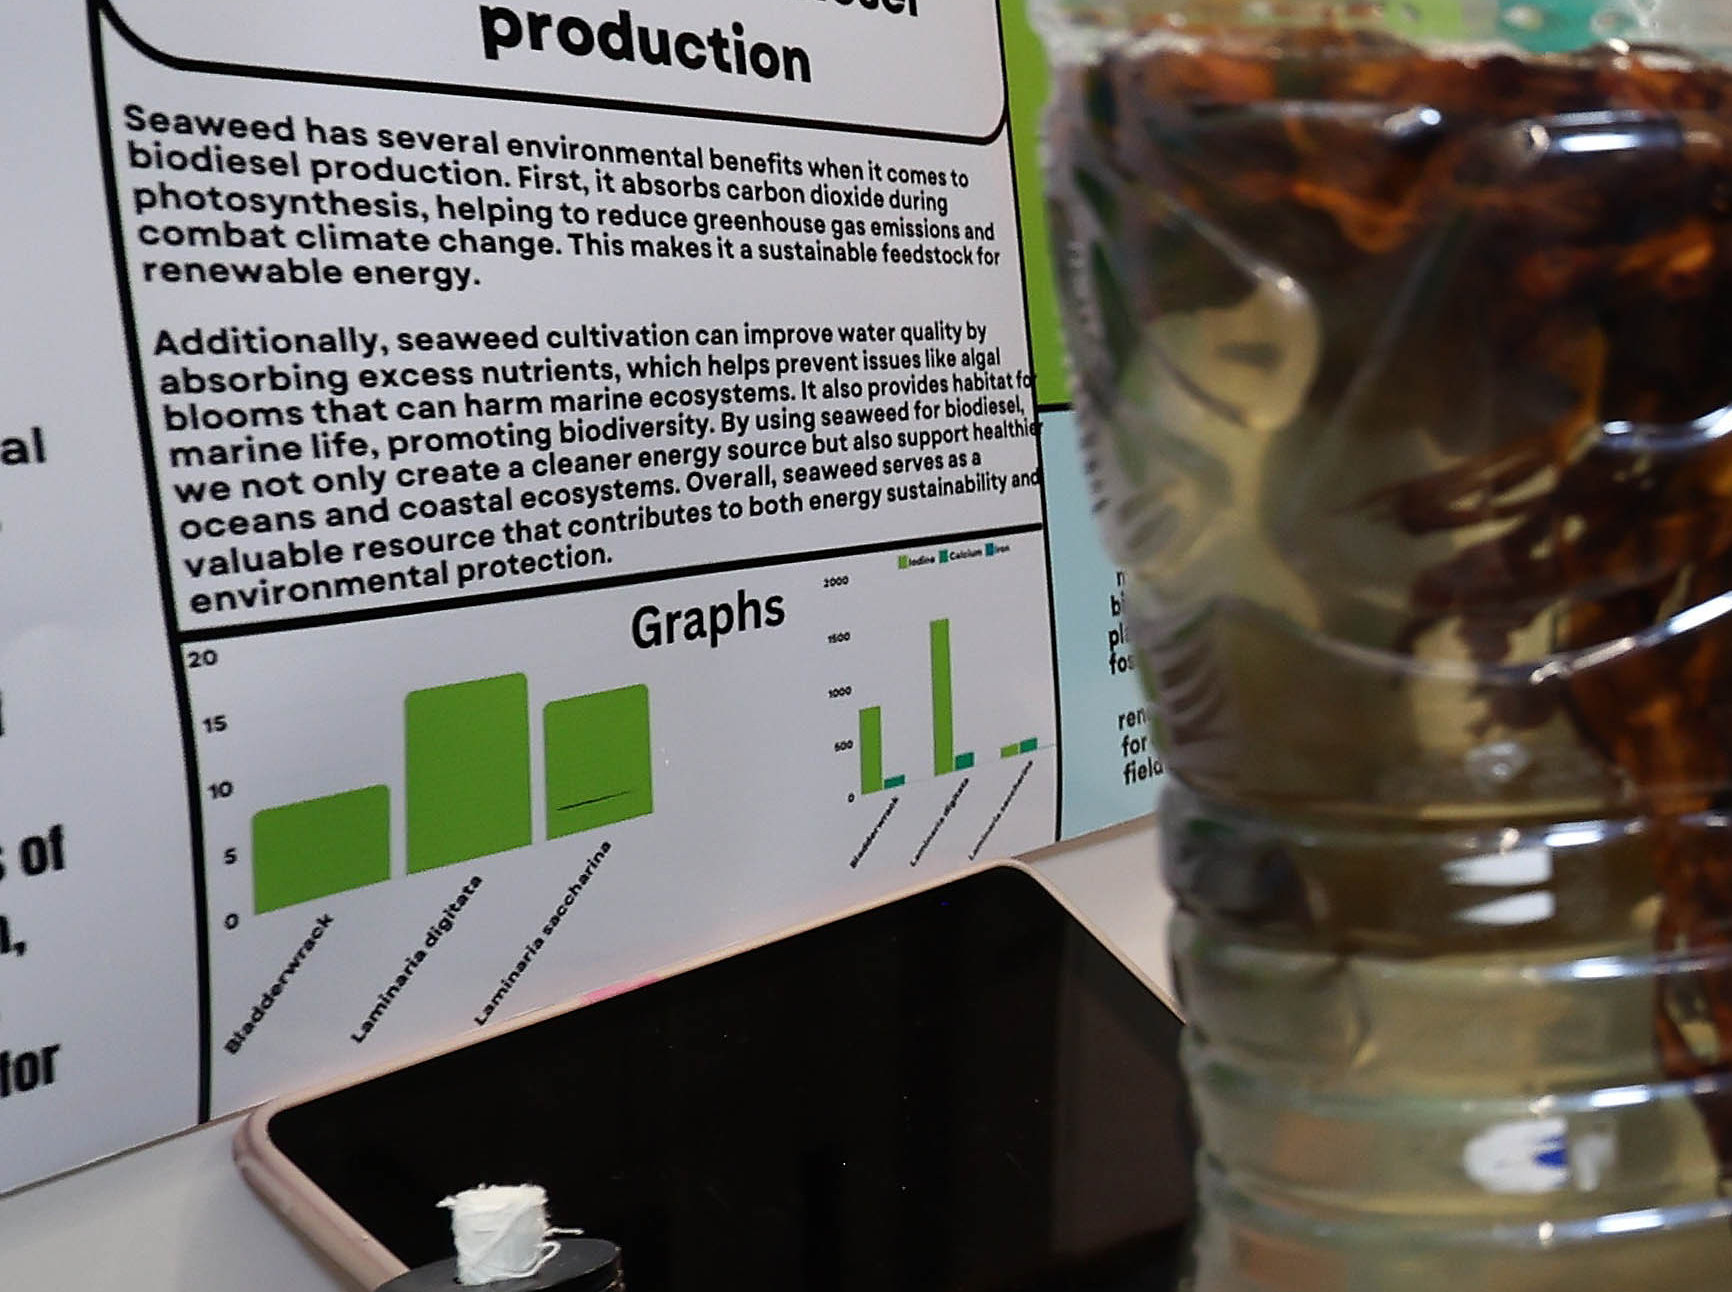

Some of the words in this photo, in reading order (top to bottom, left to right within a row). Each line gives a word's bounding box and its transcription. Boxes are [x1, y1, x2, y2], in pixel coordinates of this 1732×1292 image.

[480, 2, 813, 84] production
[124, 103, 295, 141] Seaweed
[305, 116, 367, 146] has
[377, 128, 498, 154] several
[506, 134, 703, 169] environmental
[709, 147, 802, 176] benefits
[807, 156, 863, 180] when
[867, 159, 882, 181] it
[886, 167, 946, 186] comes
[950, 169, 968, 188] to
[127, 139, 299, 176] biodiesel
[310, 156, 510, 187] production.
[517, 163, 589, 195] First,
[595, 167, 615, 193] it
[622, 171, 720, 198] absorbs
[726, 179, 804, 203] carbon
[810, 182, 884, 208] dioxide
[888, 188, 947, 217] during
[133, 181, 428, 222] photosynthesis,
[436, 194, 552, 229] helping
[559, 202, 589, 224] to
[596, 203, 687, 228] reduce
[693, 209, 825, 235] greenhouse
[831, 219, 865, 240] gas
[870, 215, 960, 239] emissions
[964, 221, 994, 240] and
[138, 220, 286, 248] combat
[296, 222, 430, 251] climate
[438, 227, 561, 260] change.
[567, 231, 624, 256] This
[630, 234, 712, 258] makes
[716, 235, 734, 258] it
[740, 243, 752, 259] a
[758, 239, 877, 262] sustainable
[881, 241, 973, 264] feedstock
[976, 245, 999, 265] for
[143, 257, 342, 283] renewable
[353, 265, 480, 291] energy.
[0, 425, 47, 465] al
[189, 559, 448, 613] environmental
[457, 543, 612, 588] protection.
[823, 575, 849, 588] 2000
[631, 590, 787, 654] Graphs
[187, 649, 218, 668] 20
[828, 686, 852, 699] 1000
[203, 716, 228, 734] 15
[208, 780, 235, 799] 10
[20, 822, 66, 877] of
[223, 847, 238, 866] 5
[849, 795, 899, 869] Bladderwrack
[224, 913, 240, 931] 0
[473, 936, 545, 1026] Laminaria
[542, 840, 612, 936] saccharina
[224, 912, 335, 1056] Bladderwrack
[350, 949, 427, 1044] Laminaria
[424, 874, 483, 948] digitata
